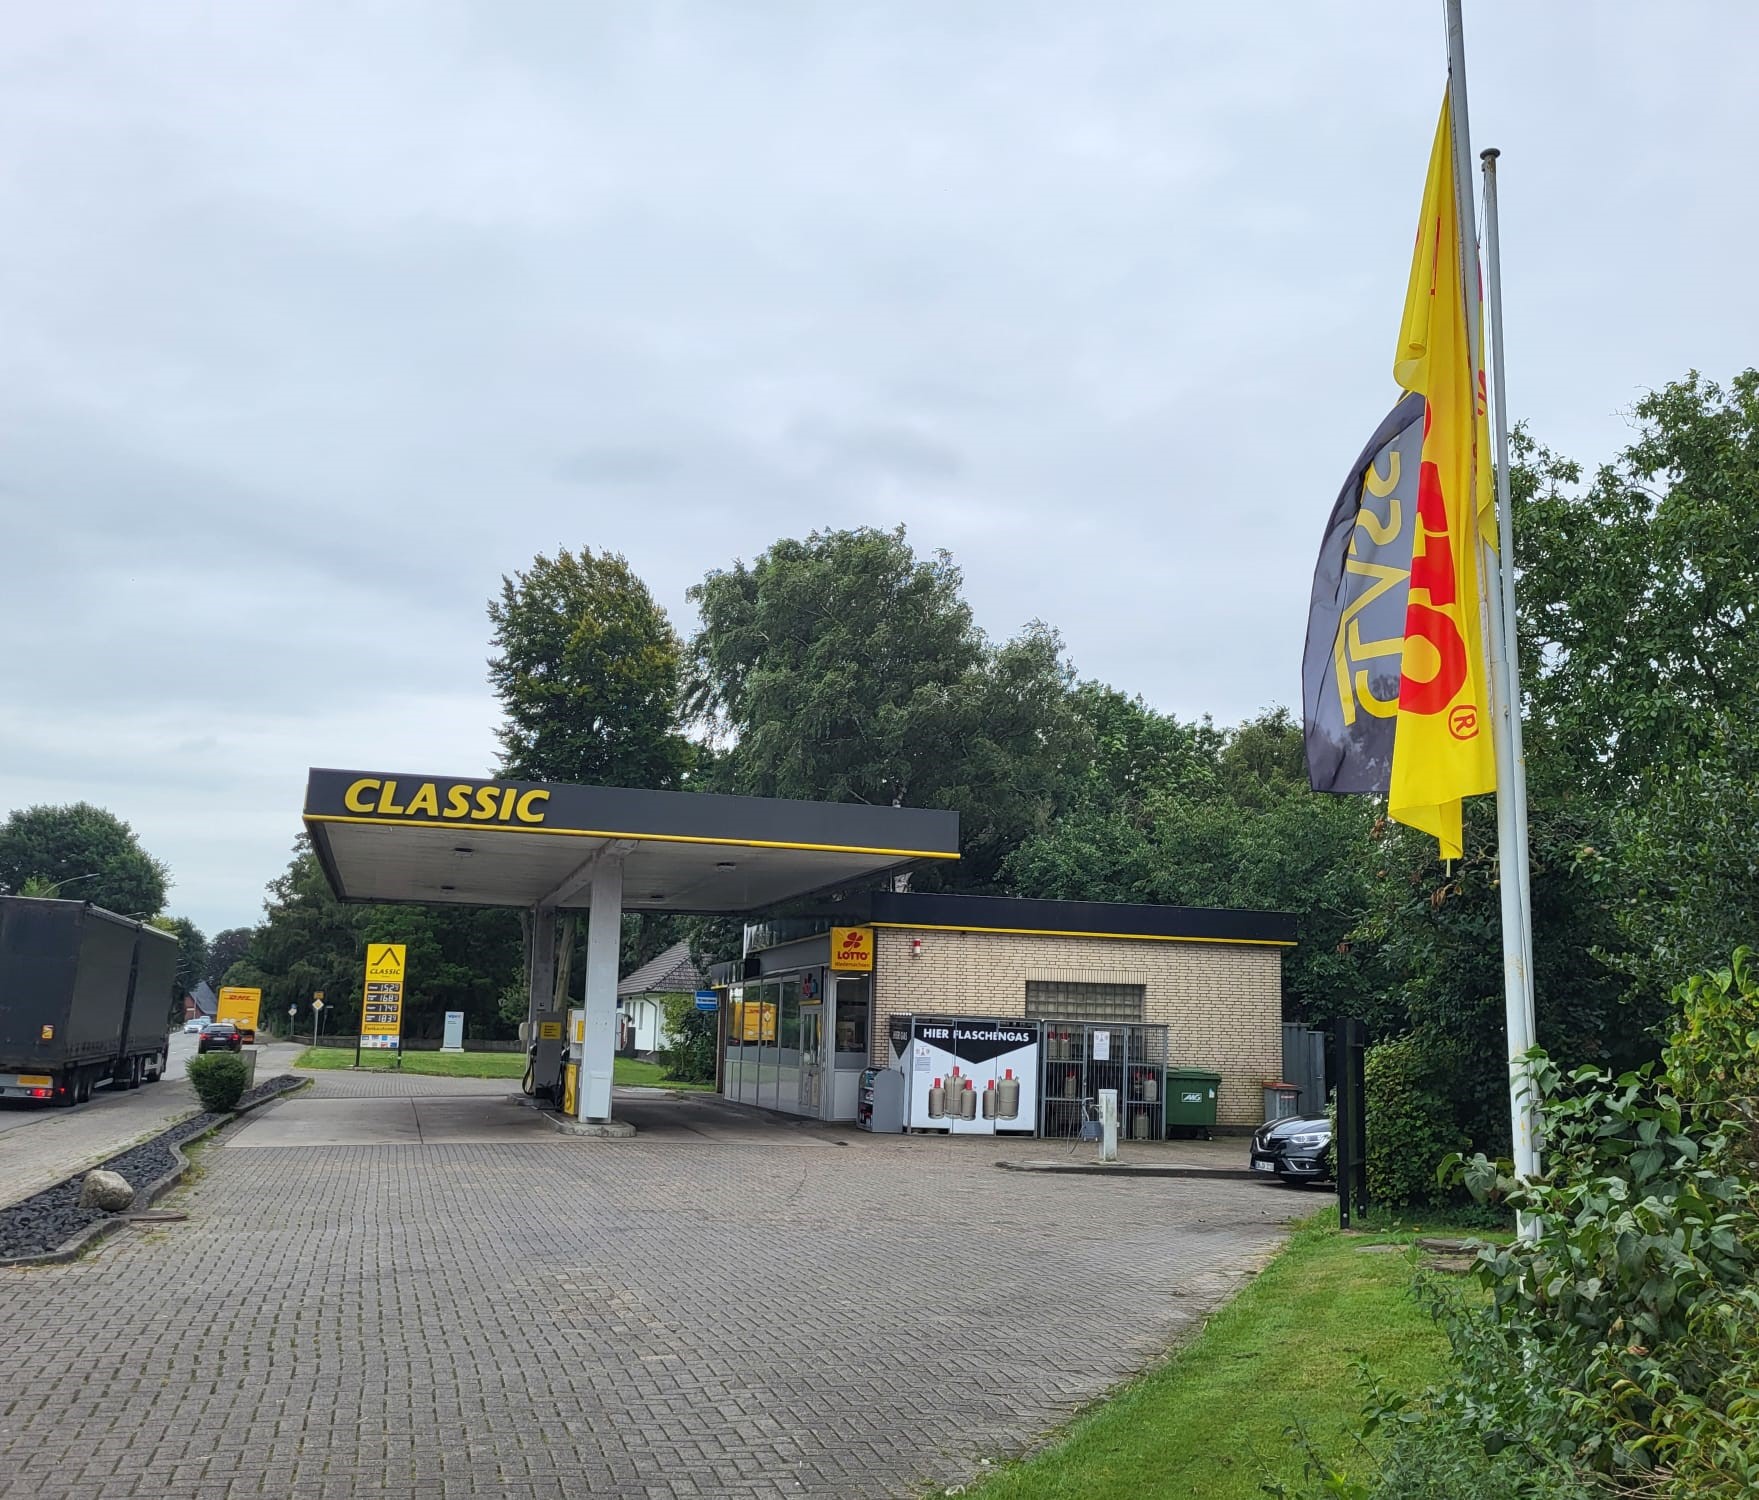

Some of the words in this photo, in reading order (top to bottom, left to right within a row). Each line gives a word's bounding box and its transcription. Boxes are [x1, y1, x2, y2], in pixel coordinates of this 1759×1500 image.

[344, 778, 550, 823] CLASSIC
[837, 951, 868, 961] LOTTO
[923, 1028, 950, 1039] HIER
[953, 1029, 1030, 1042] FLASCHENGAS
